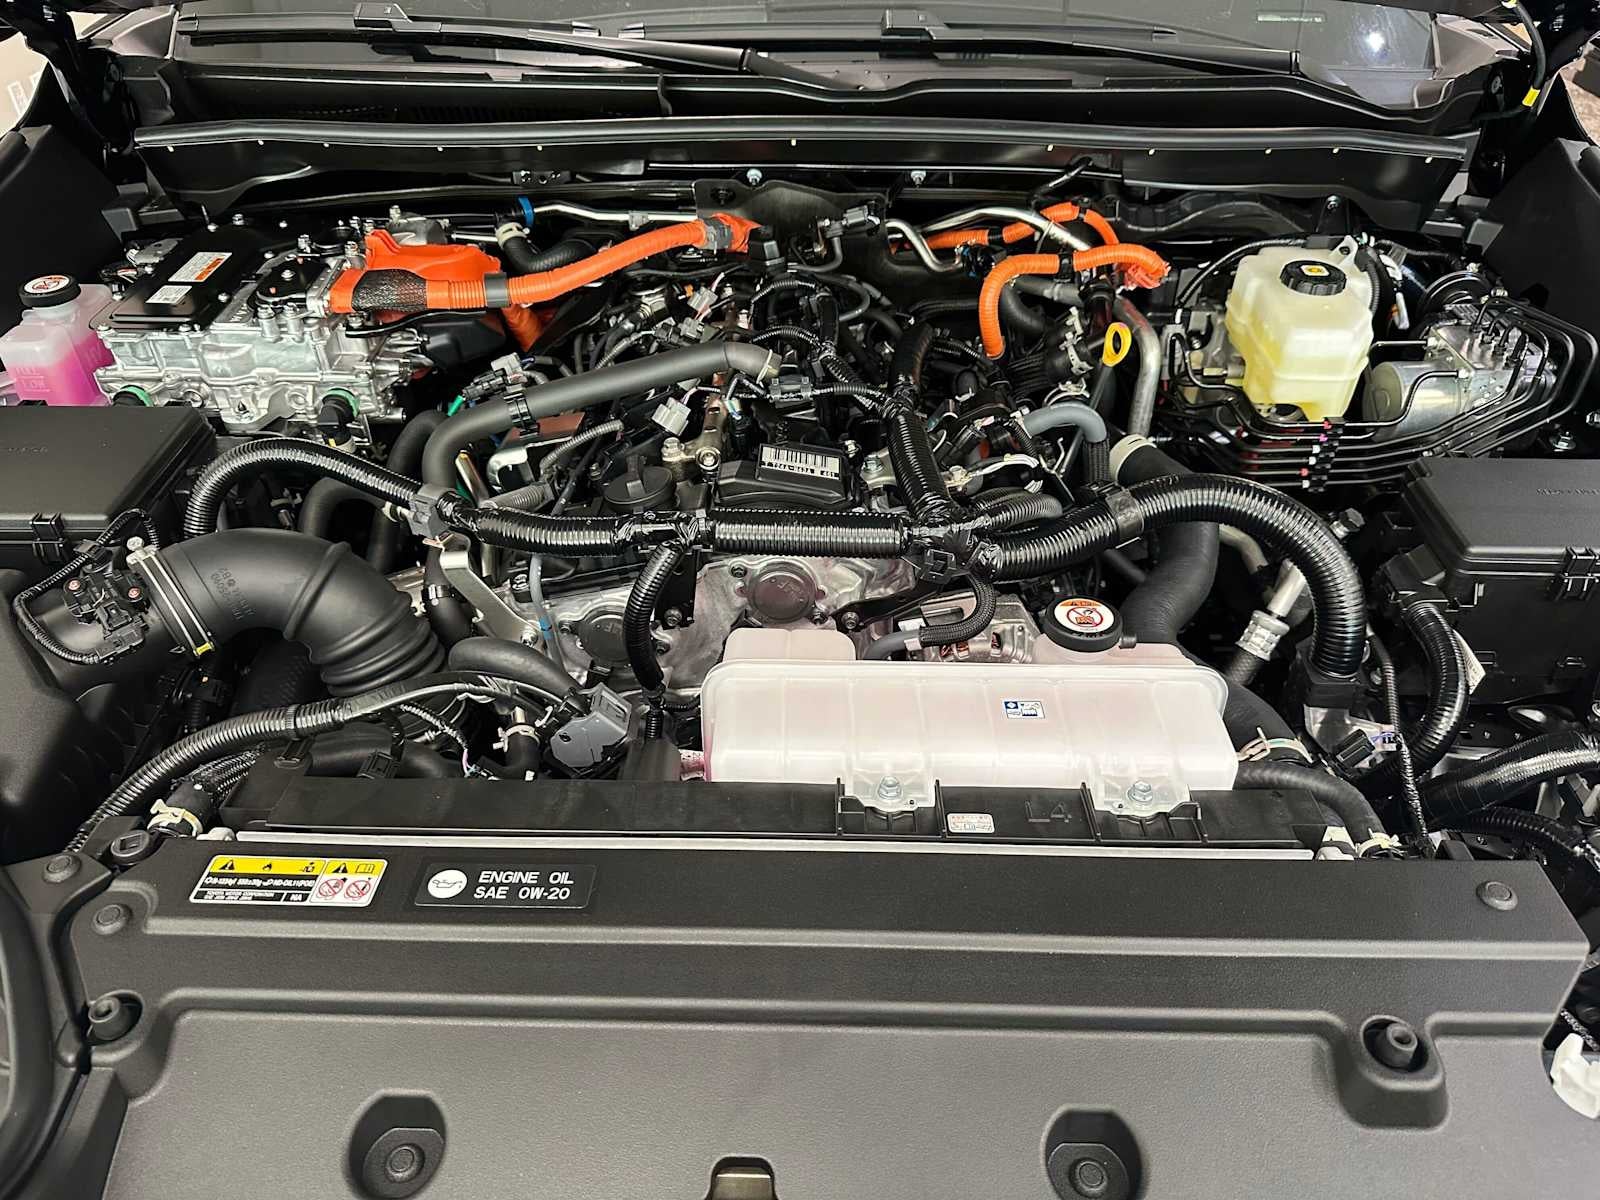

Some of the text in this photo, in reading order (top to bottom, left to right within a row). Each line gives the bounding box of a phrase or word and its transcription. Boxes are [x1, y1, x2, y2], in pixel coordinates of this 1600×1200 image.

[478, 870, 574, 885] ENGINE OIL
[473, 886, 571, 900] SAE 0W-20
